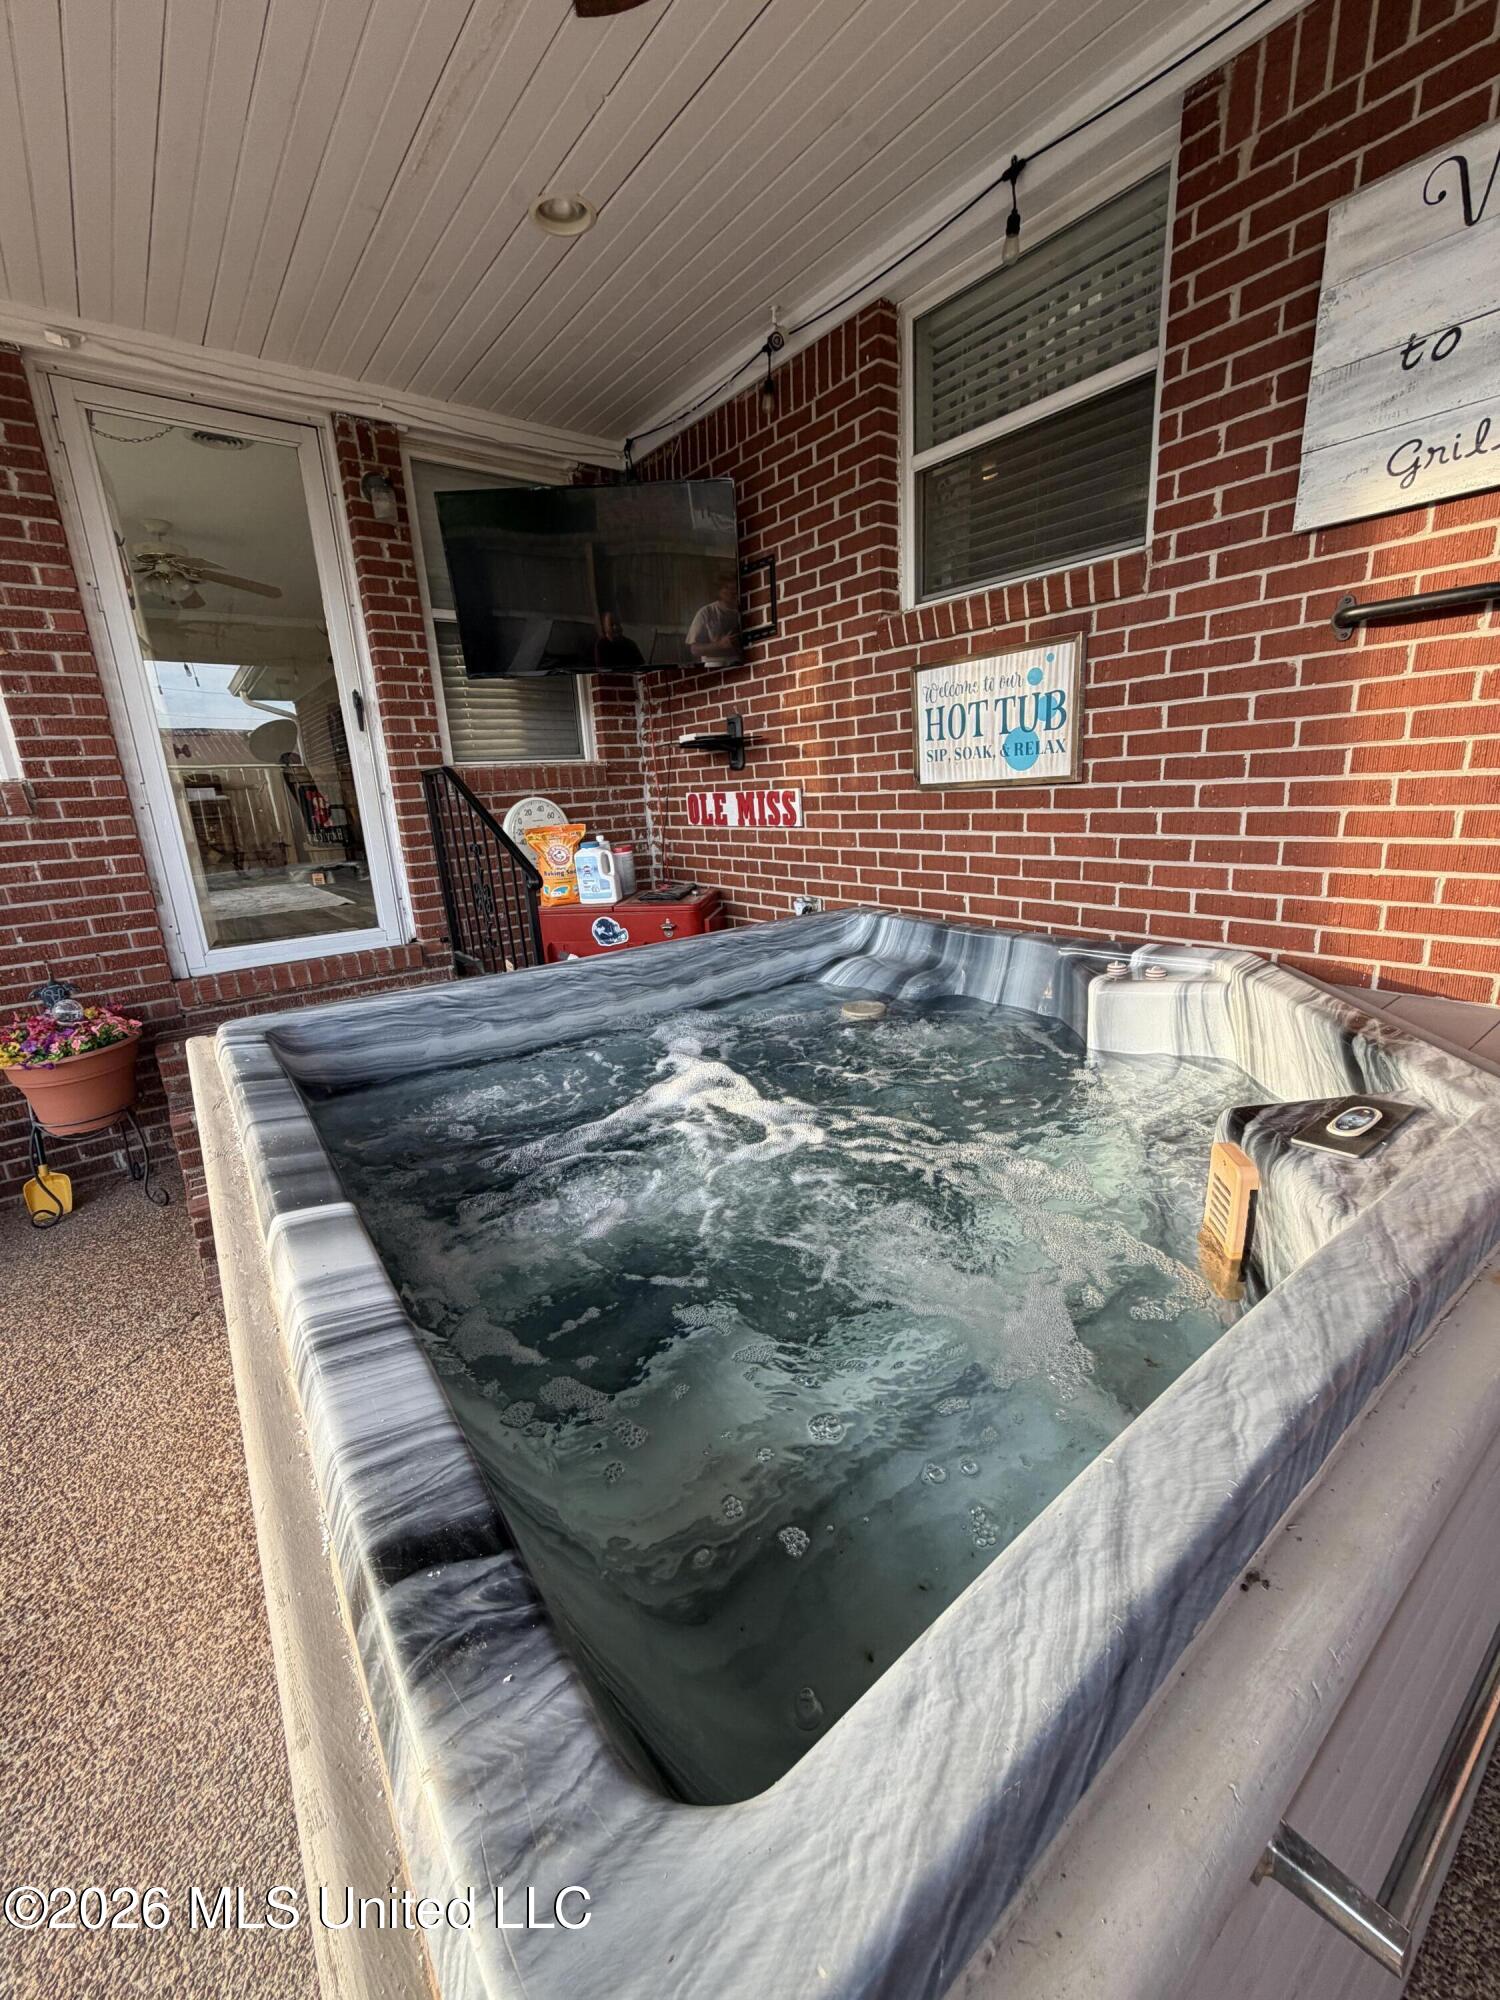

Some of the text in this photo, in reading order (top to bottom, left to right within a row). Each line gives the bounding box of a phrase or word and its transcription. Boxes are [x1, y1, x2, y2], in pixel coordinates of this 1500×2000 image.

[1400, 326, 1462, 371] to
[1386, 417, 1500, 489] Gril
[923, 672, 1024, 703] Welcome to our
[925, 689, 1067, 741] HOT TUB
[954, 745, 996, 761] SOAK,
[1000, 743, 1010, 757] &
[1014, 738, 1066, 756] RELAX
[687, 790, 797, 827] OLE MISS
